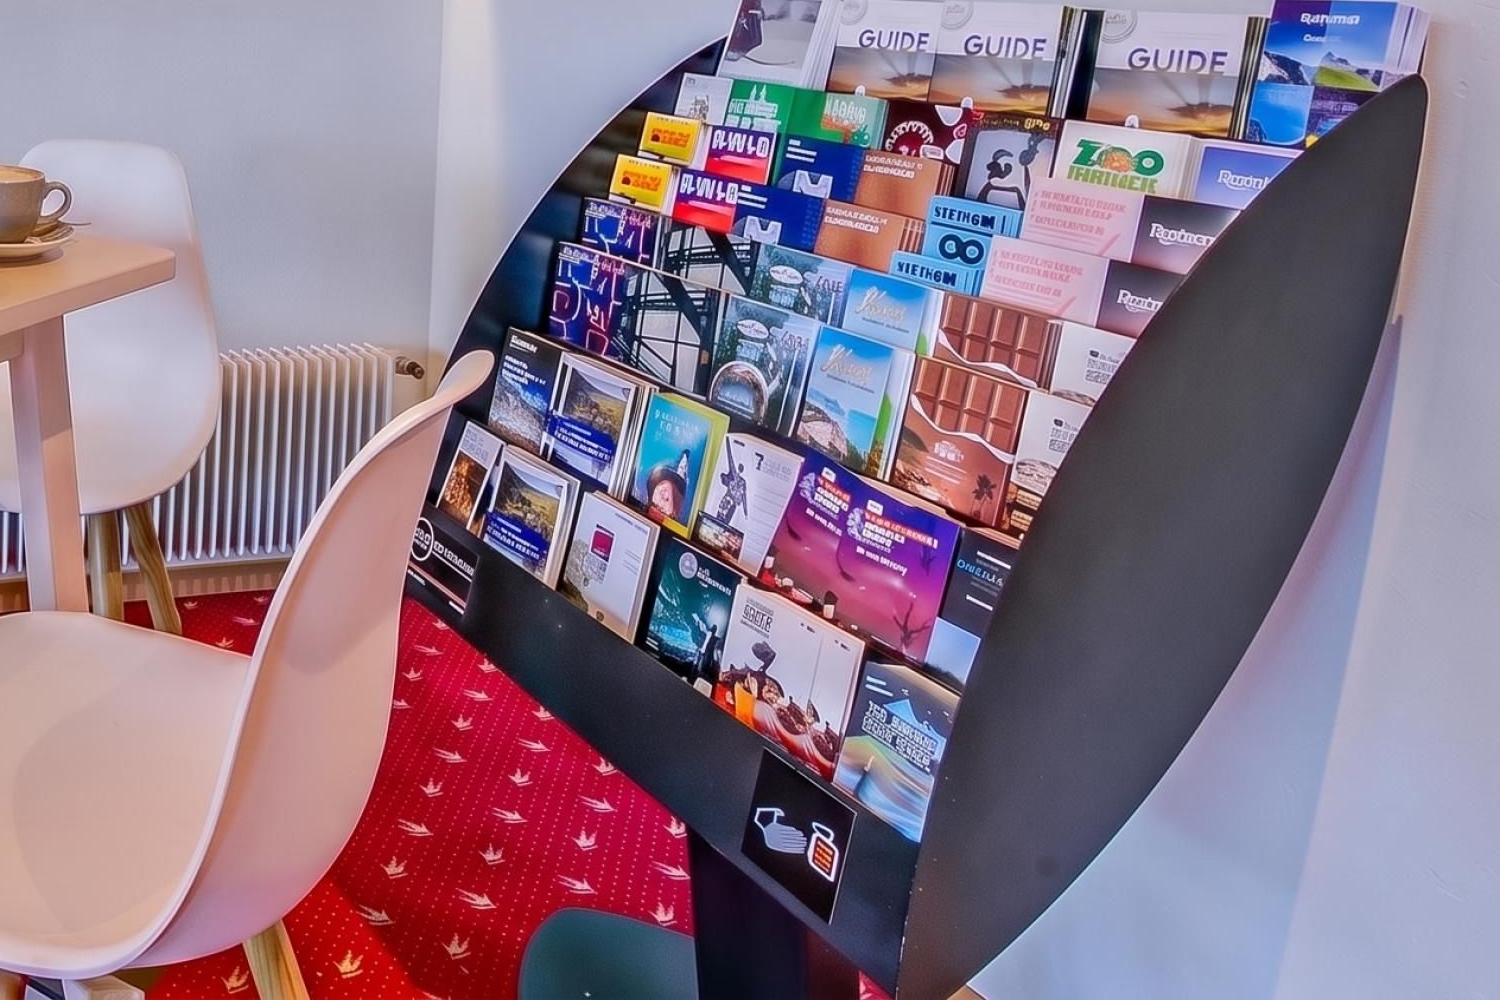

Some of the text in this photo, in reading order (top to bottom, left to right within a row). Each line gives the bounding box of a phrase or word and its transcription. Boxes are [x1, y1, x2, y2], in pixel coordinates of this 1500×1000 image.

[858, 29, 930, 52] GUIDE
[964, 35, 1047, 60] GUIDE
[1128, 47, 1228, 74] GUIDE
